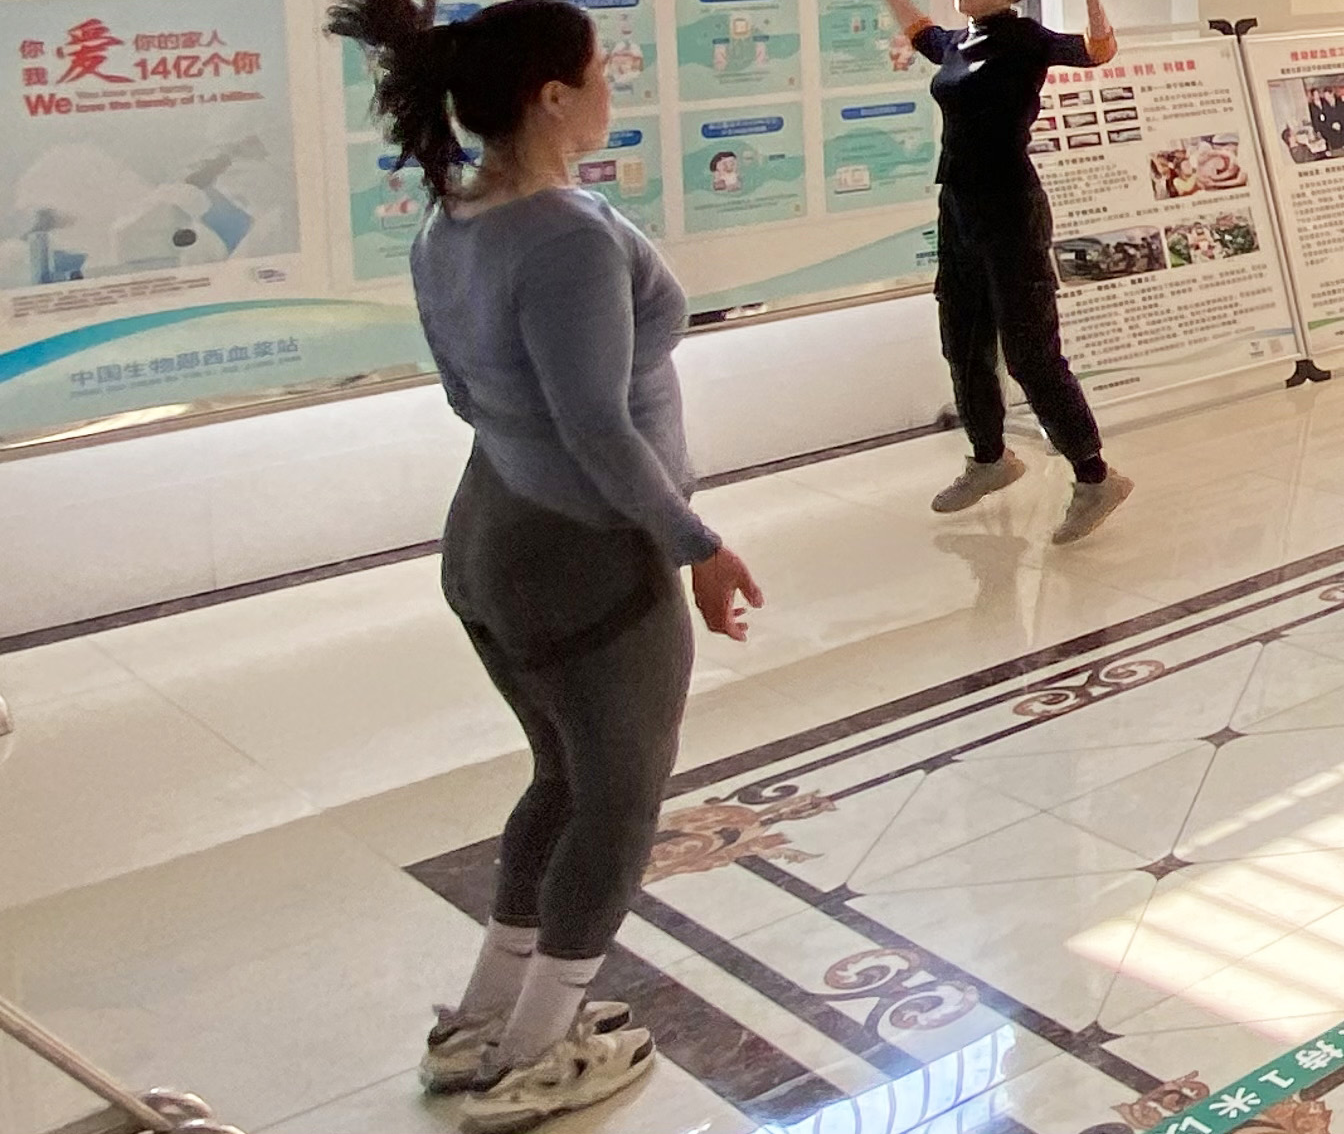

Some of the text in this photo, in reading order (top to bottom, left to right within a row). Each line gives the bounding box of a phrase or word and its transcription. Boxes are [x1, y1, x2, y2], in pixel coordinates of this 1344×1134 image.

[19, 39, 45, 59] 你
[55, 18, 136, 84] 爱
[132, 29, 227, 51] 你的家人
[22, 66, 48, 86] 我
[133, 51, 261, 80] 14亿个你
[23, 93, 73, 116] We
